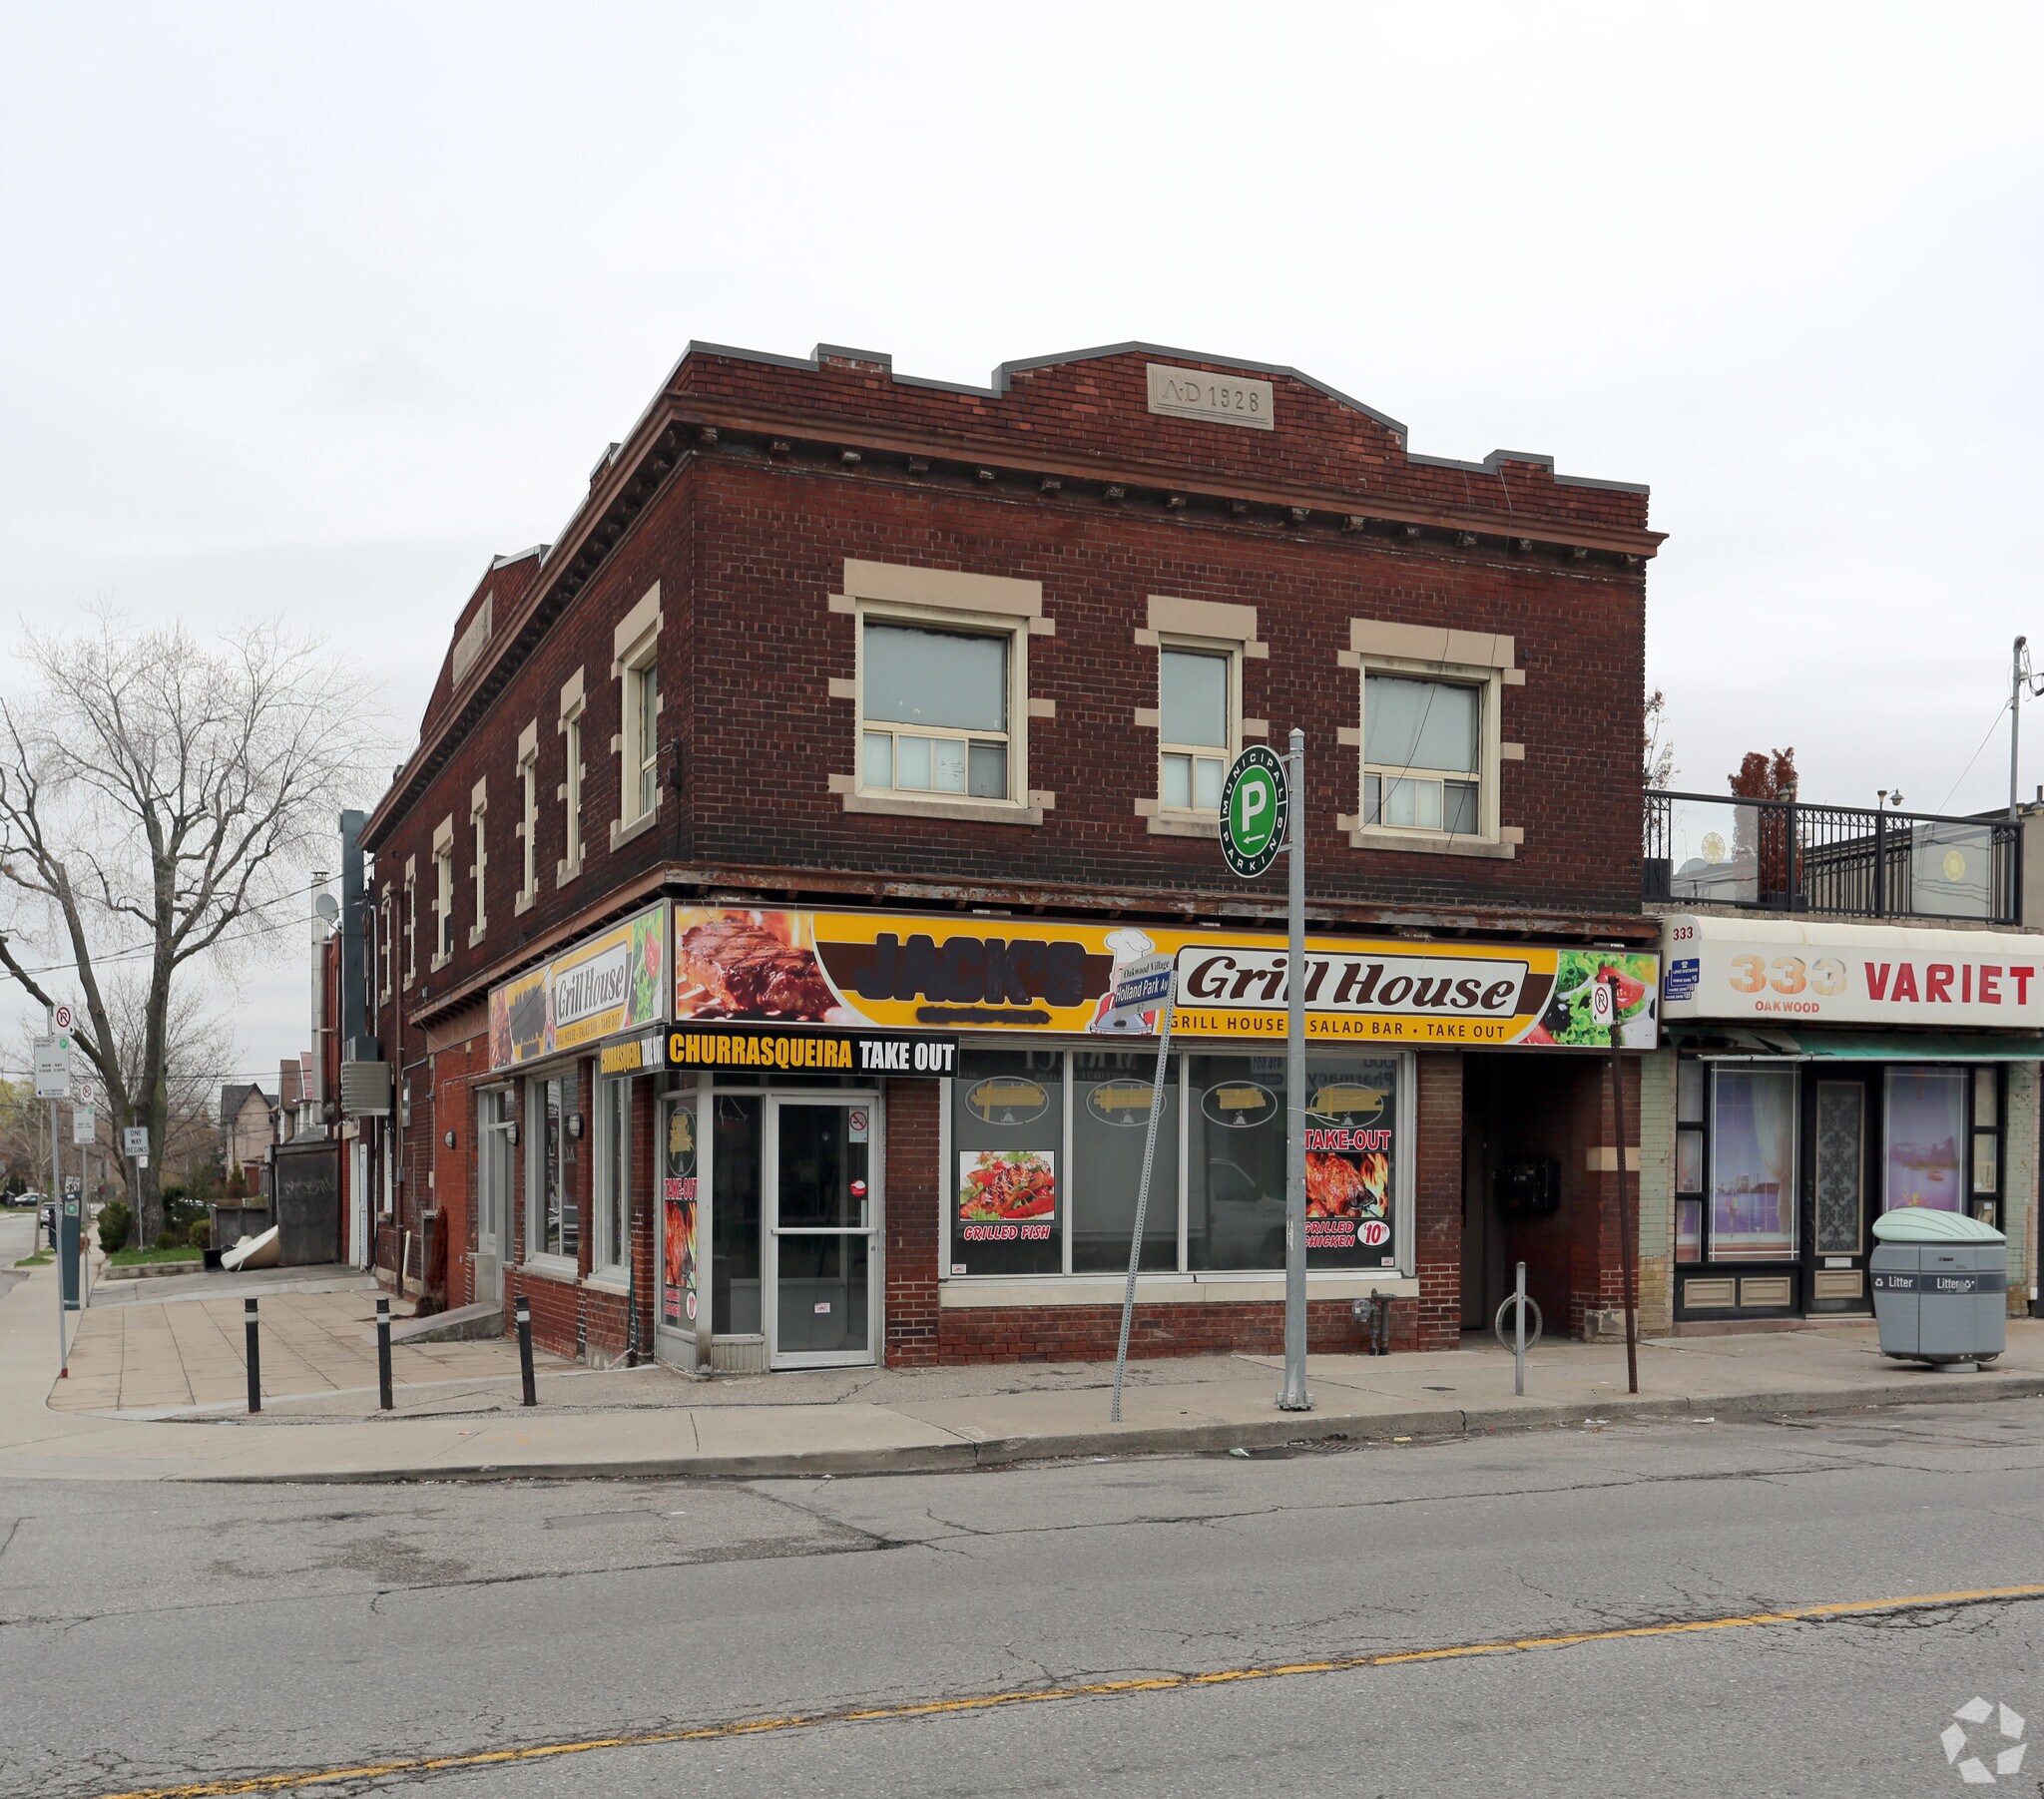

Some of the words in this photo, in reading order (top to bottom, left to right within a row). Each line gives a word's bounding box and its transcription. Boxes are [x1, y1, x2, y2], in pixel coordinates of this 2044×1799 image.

[1209, 386, 1260, 412] 1928
[1222, 753, 1284, 814] MUNICIPAL
[1242, 780, 1268, 832] P
[1223, 817, 1283, 871] PARKING
[1673, 926, 1694, 940] 333
[1124, 964, 1150, 978] Oakwood
[1151, 960, 1171, 972] Village
[1728, 954, 1848, 997] 333
[558, 968, 585, 1020] Grill
[585, 964, 625, 1011] House
[1116, 981, 1143, 1002] Holland
[1143, 977, 1160, 997] Park
[1333, 962, 1515, 1010] House
[1755, 1000, 1820, 1014] OAKWOOD
[1171, 1015, 1219, 1030] GRILL
[1227, 1017, 1284, 1032] HOUSE
[1309, 1020, 1364, 1034] SALAD
[1371, 1022, 1403, 1035] BAR
[1426, 1024, 1465, 1037] TAKE
[1473, 1026, 1505, 1039] OUT
[669, 1033, 852, 1069] CHURRASQUEIRA
[859, 1041, 909, 1070] TAKE
[914, 1043, 955, 1071] OUT
[1305, 1128, 1392, 1150] TAKE-OUT
[964, 1225, 1018, 1241] GRILLED
[1021, 1225, 1051, 1240] FISH
[1305, 1220, 1354, 1234] GRILLED
[1888, 1276, 1913, 1288] Litter
[1936, 1277, 1959, 1289] Litter
